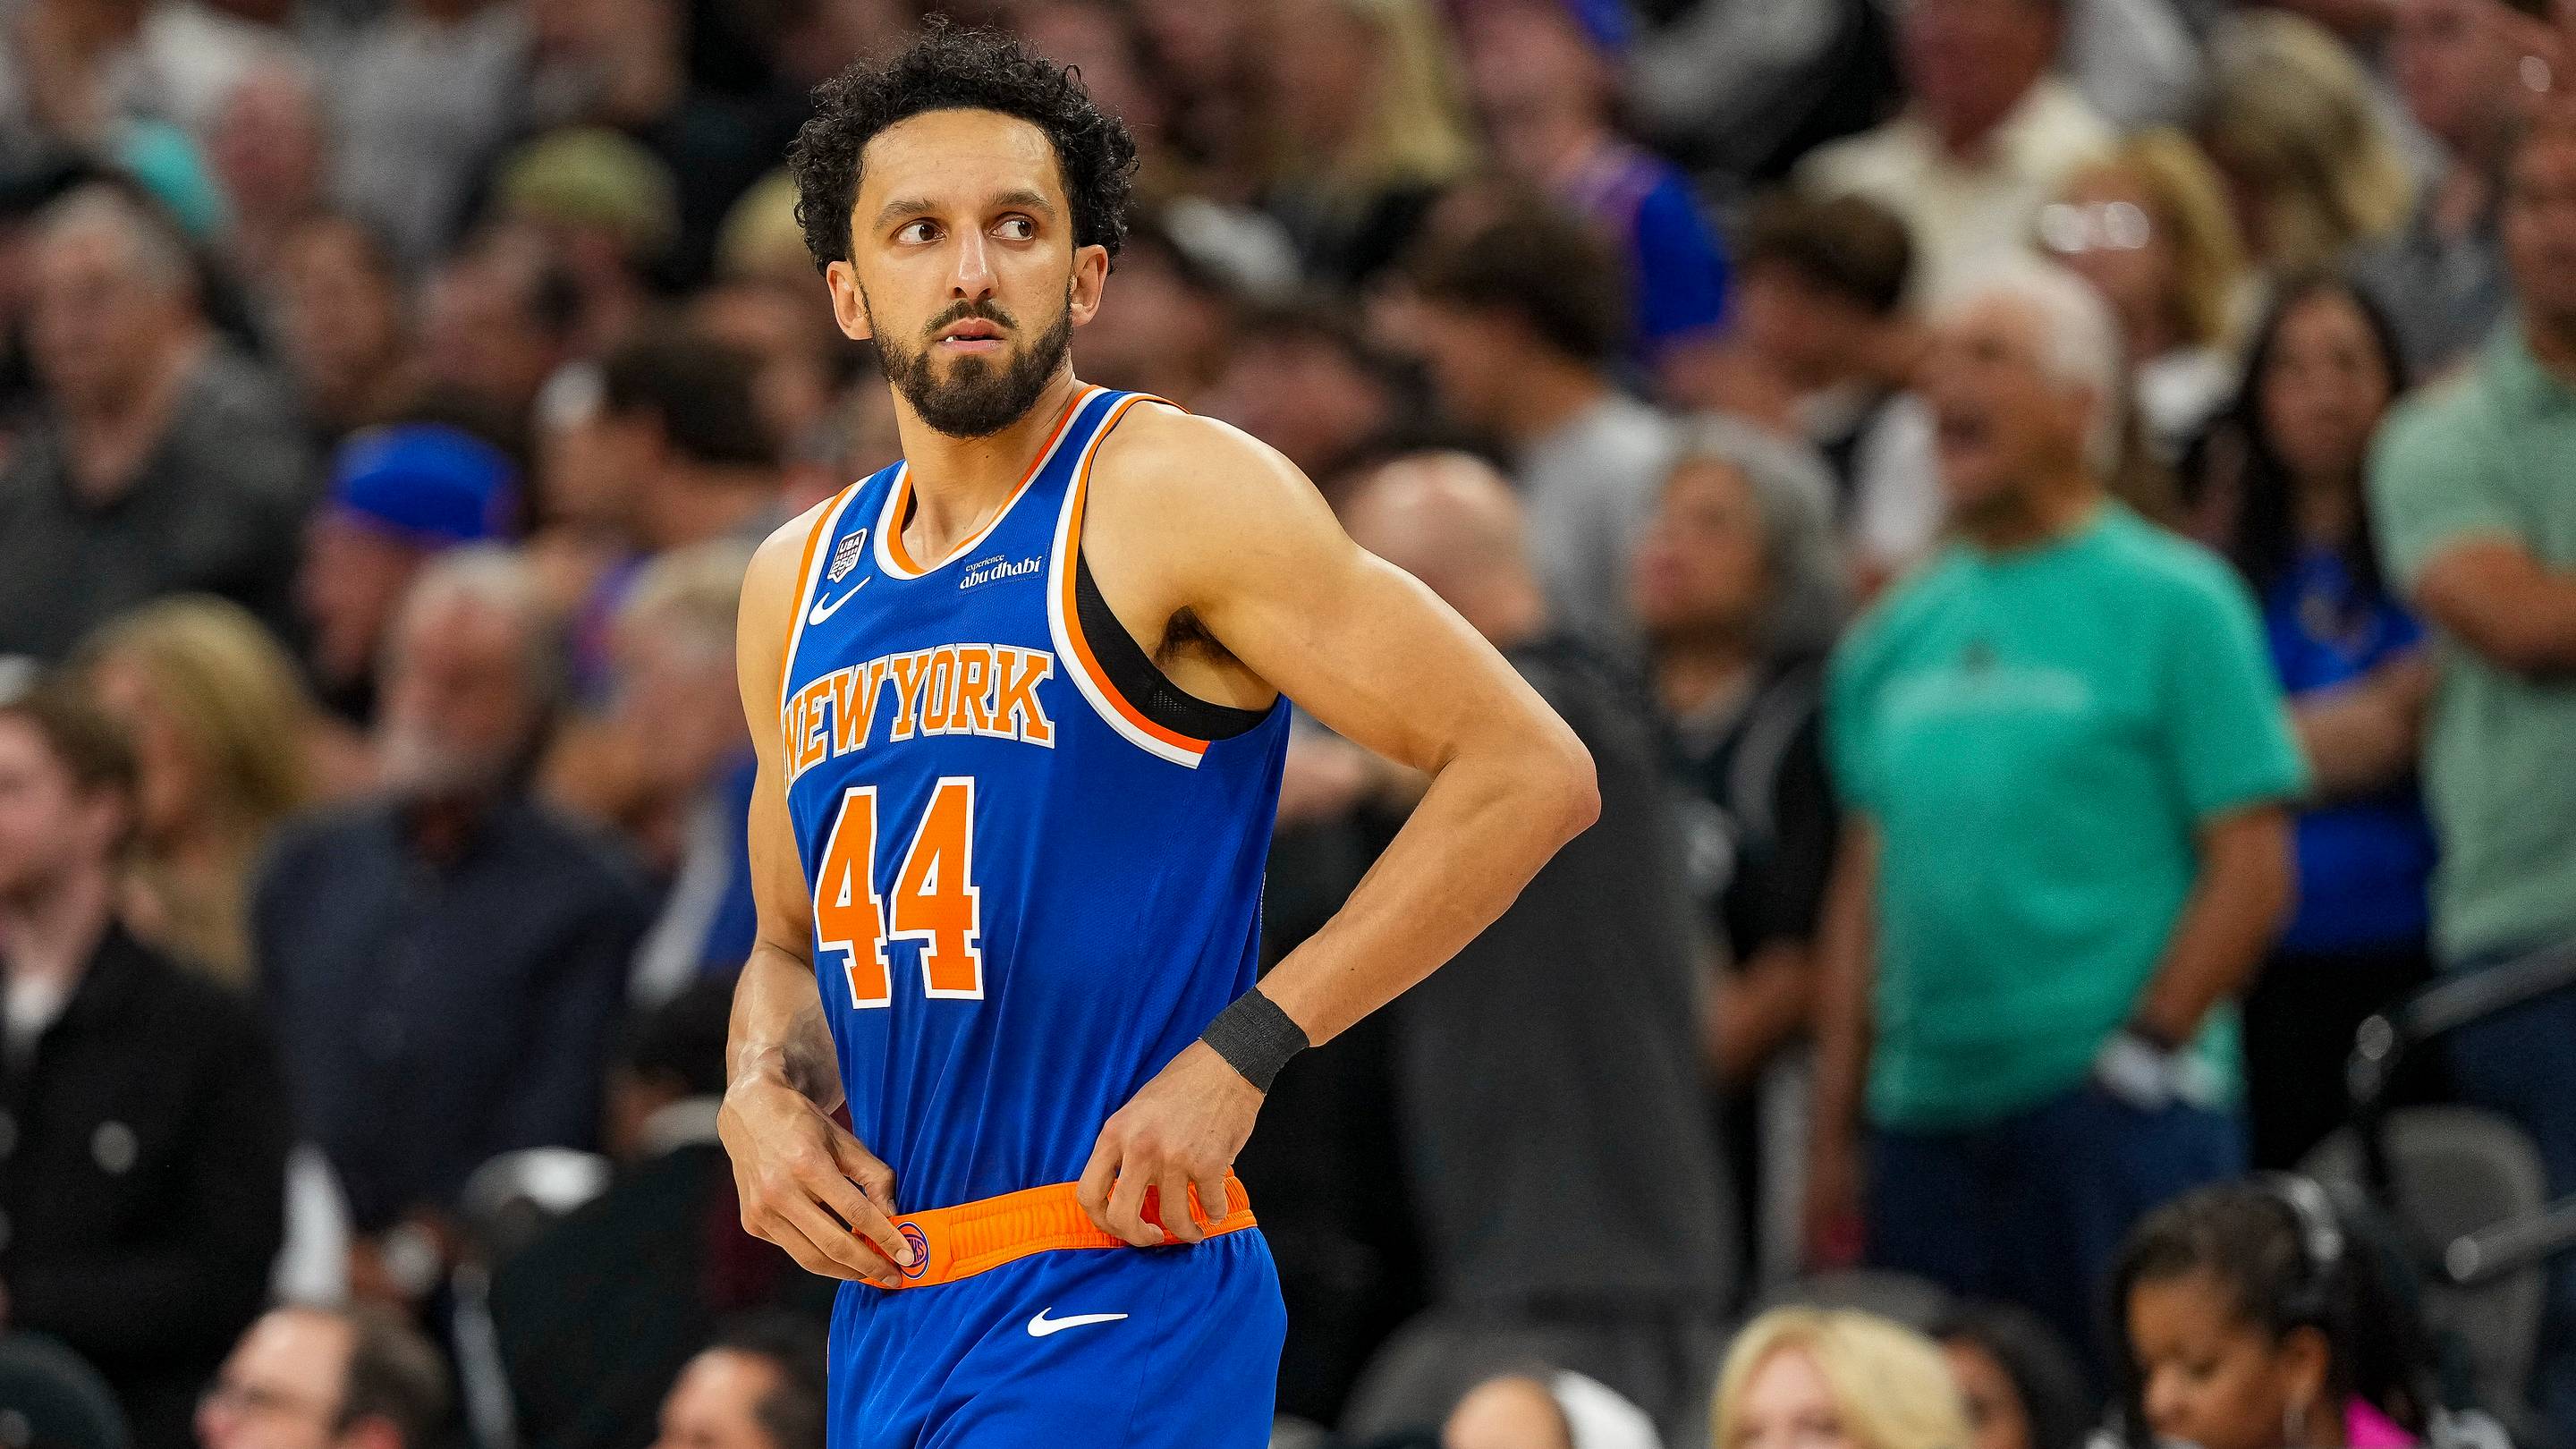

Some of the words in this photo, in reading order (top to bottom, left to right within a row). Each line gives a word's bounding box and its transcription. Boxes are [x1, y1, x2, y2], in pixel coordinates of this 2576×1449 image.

[832, 553, 856, 573] 250
[960, 570, 988, 589] abu
[990, 555, 1042, 580] dhabi
[966, 555, 1004, 572] experience
[784, 654, 889, 795] NEW
[887, 642, 1055, 749] YORK
[814, 776, 984, 1009] 44
